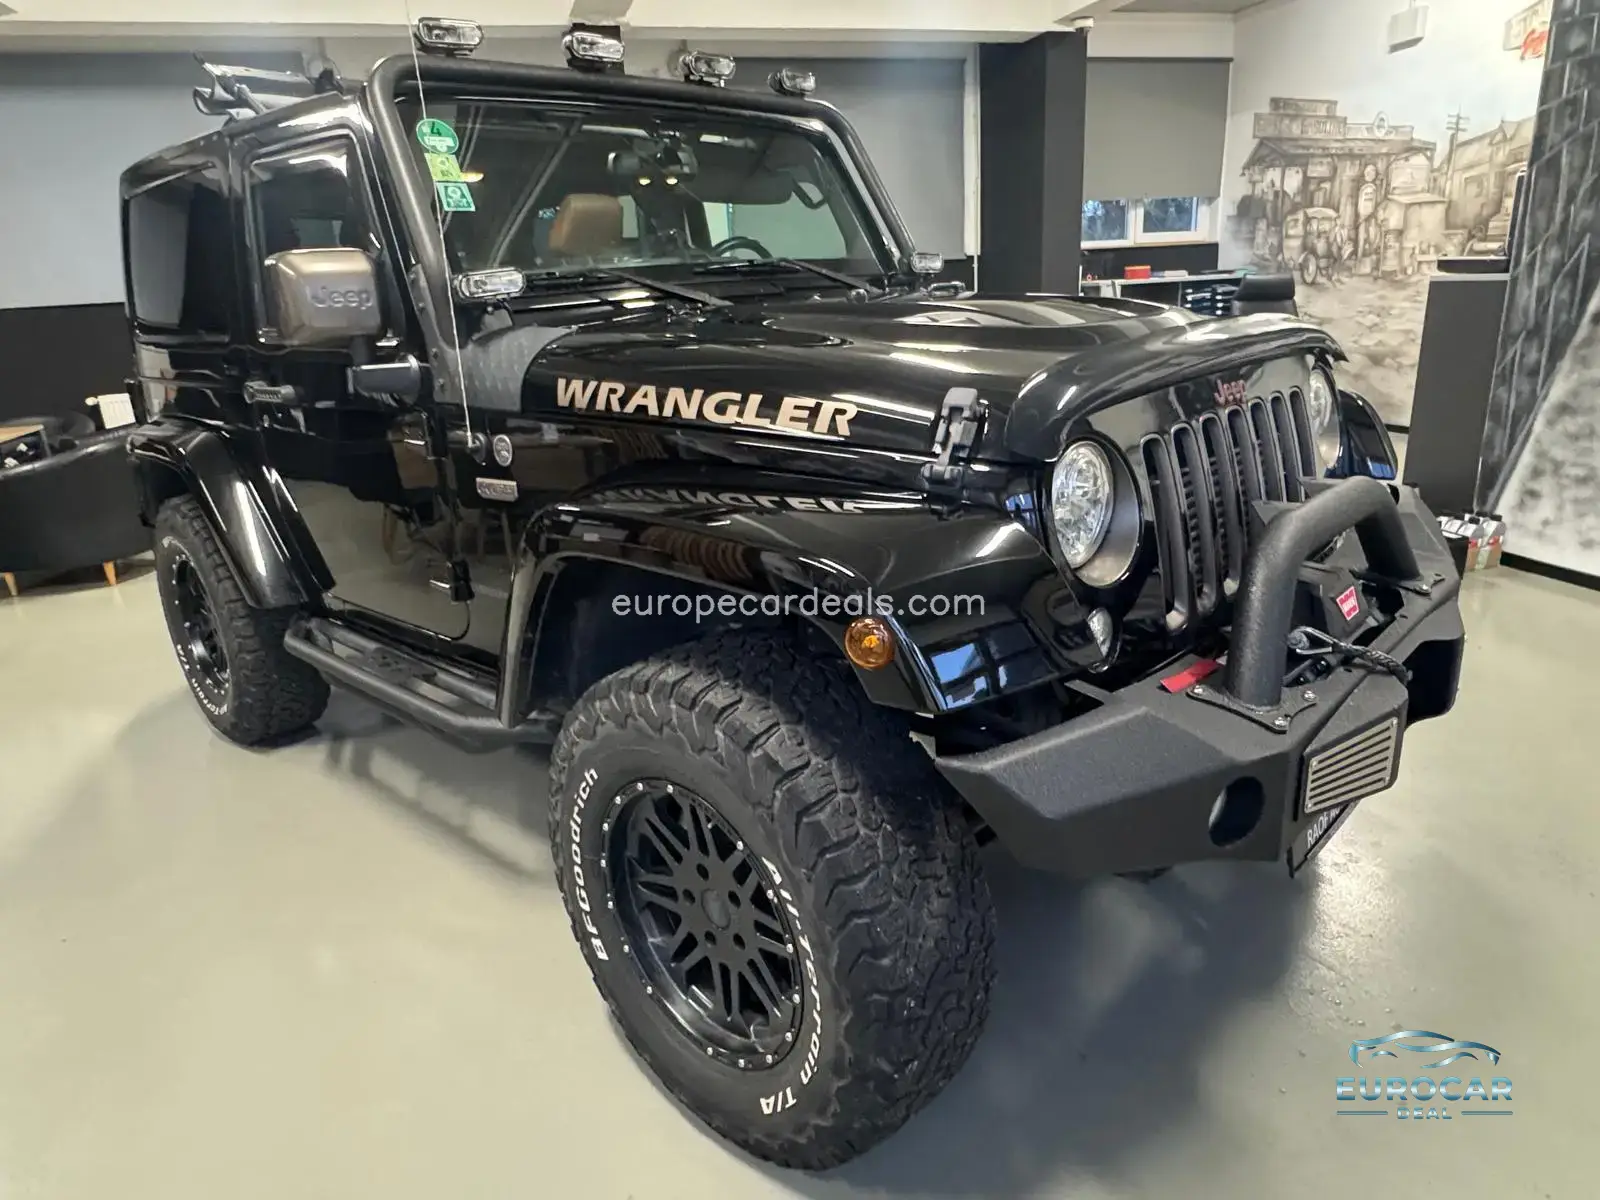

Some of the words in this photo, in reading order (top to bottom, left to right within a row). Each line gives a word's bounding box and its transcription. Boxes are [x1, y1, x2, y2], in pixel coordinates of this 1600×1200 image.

[430, 121, 443, 137] 4
[311, 285, 373, 311] Jeep
[556, 377, 858, 437] WRANGLER
[1213, 378, 1248, 408] Jeep
[569, 767, 609, 961] BFGoodrich
[760, 1086, 797, 1115] T/A
